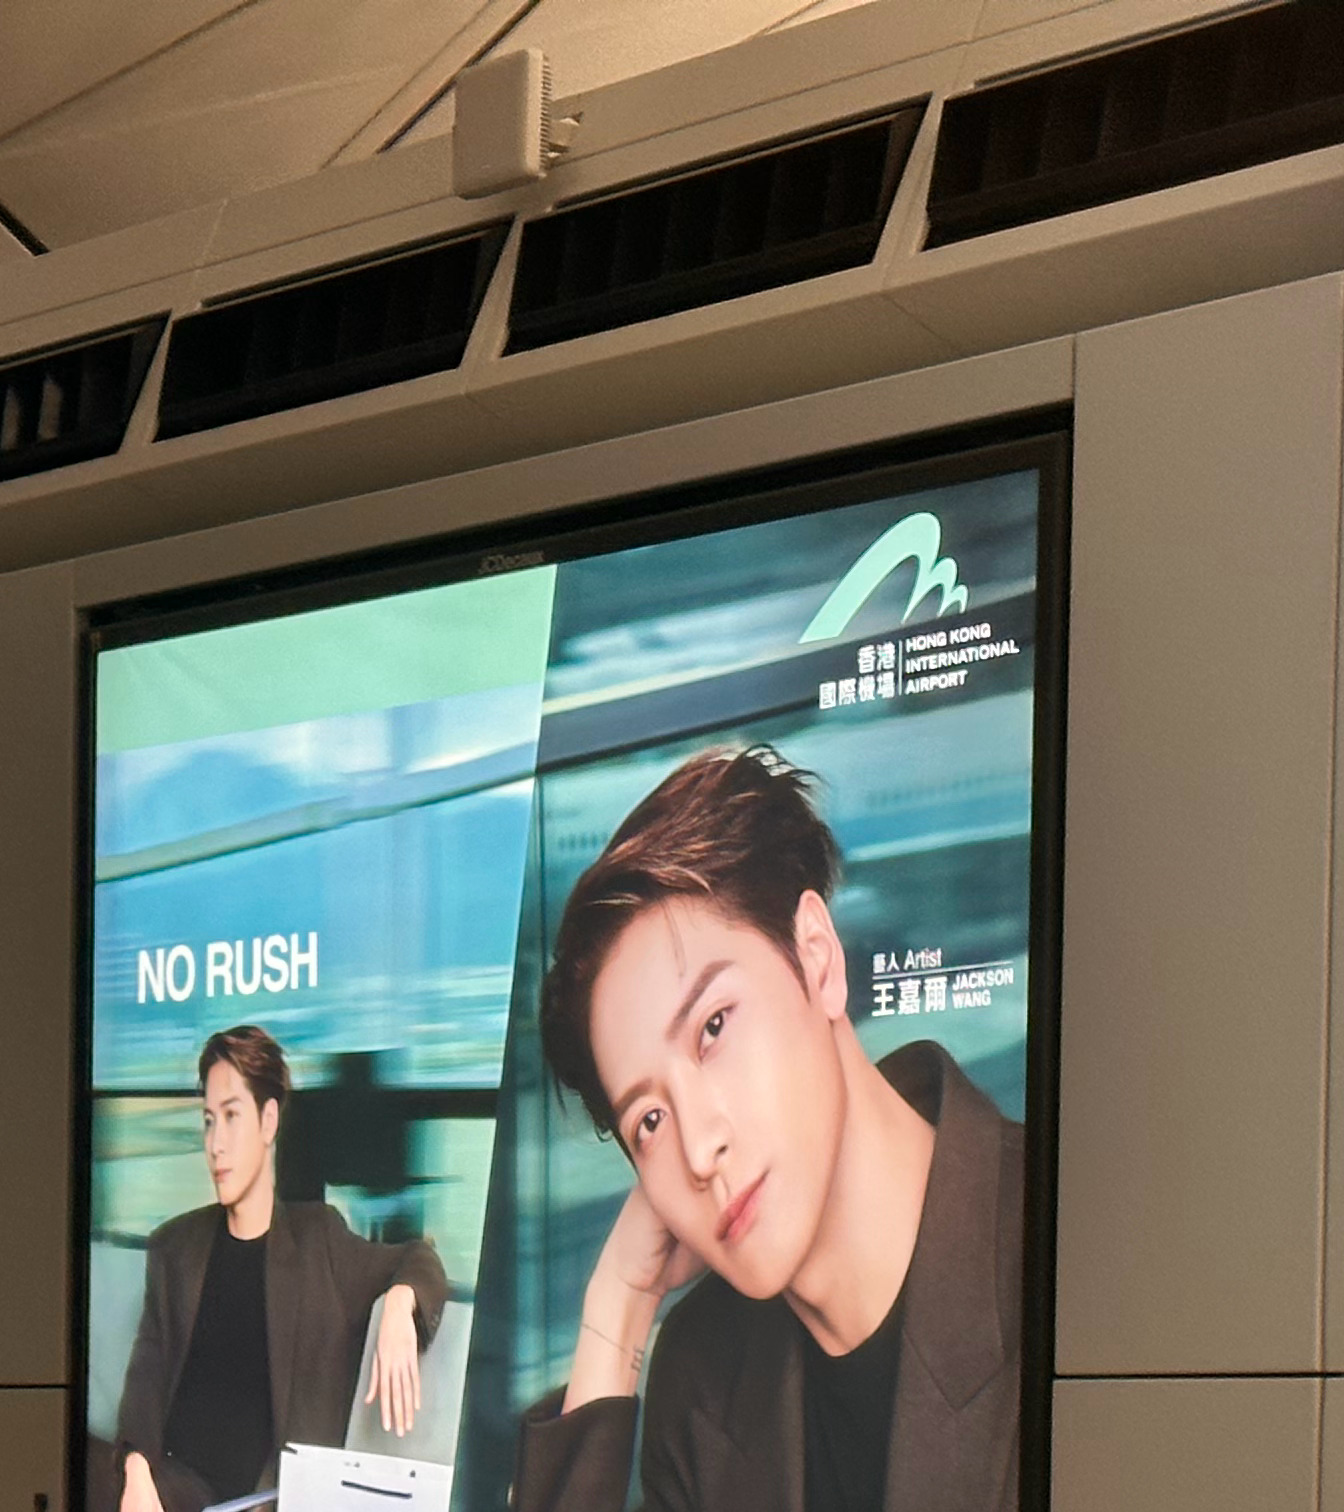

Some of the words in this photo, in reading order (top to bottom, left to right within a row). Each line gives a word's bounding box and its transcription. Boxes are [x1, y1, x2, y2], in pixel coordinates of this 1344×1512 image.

[905, 630, 947, 653] HONG
[949, 622, 991, 644] KONG
[857, 641, 897, 674] 香港
[905, 639, 1020, 673] INTERNATIONAL
[818, 672, 897, 710] 國際機場
[905, 669, 968, 695] AIRPORT
[137, 944, 196, 1004] NO
[205, 931, 319, 998] RUSH
[903, 947, 942, 970] Artist
[952, 967, 1015, 991] JACKSON
[871, 975, 949, 1017] 王嘉爾
[952, 989, 992, 1009] WANG
